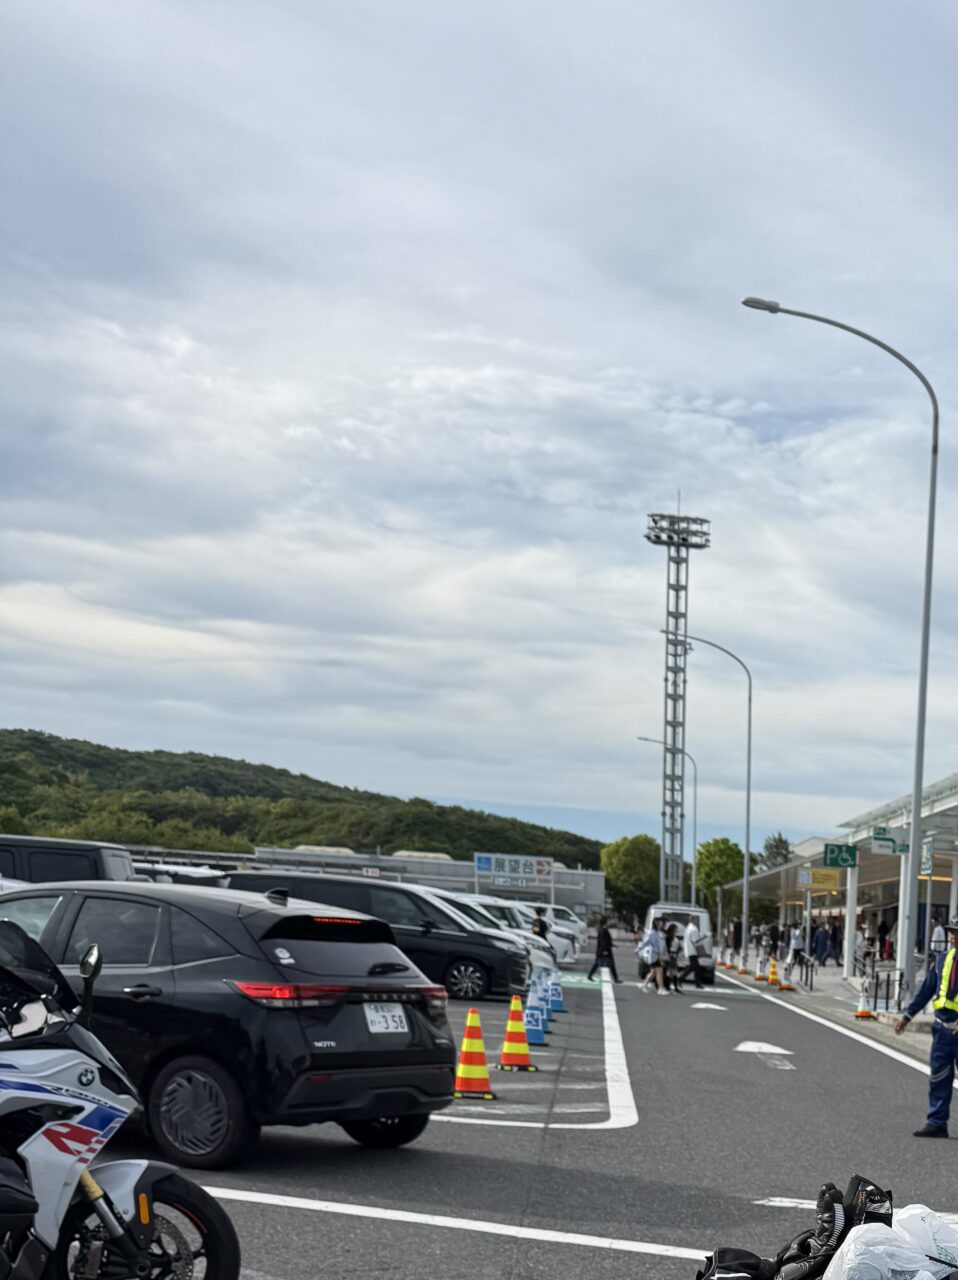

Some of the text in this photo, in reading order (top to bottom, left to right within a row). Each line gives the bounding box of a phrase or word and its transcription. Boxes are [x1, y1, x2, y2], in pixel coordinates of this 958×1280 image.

[826, 845, 839, 865] P
[496, 858, 535, 875] 展望台
